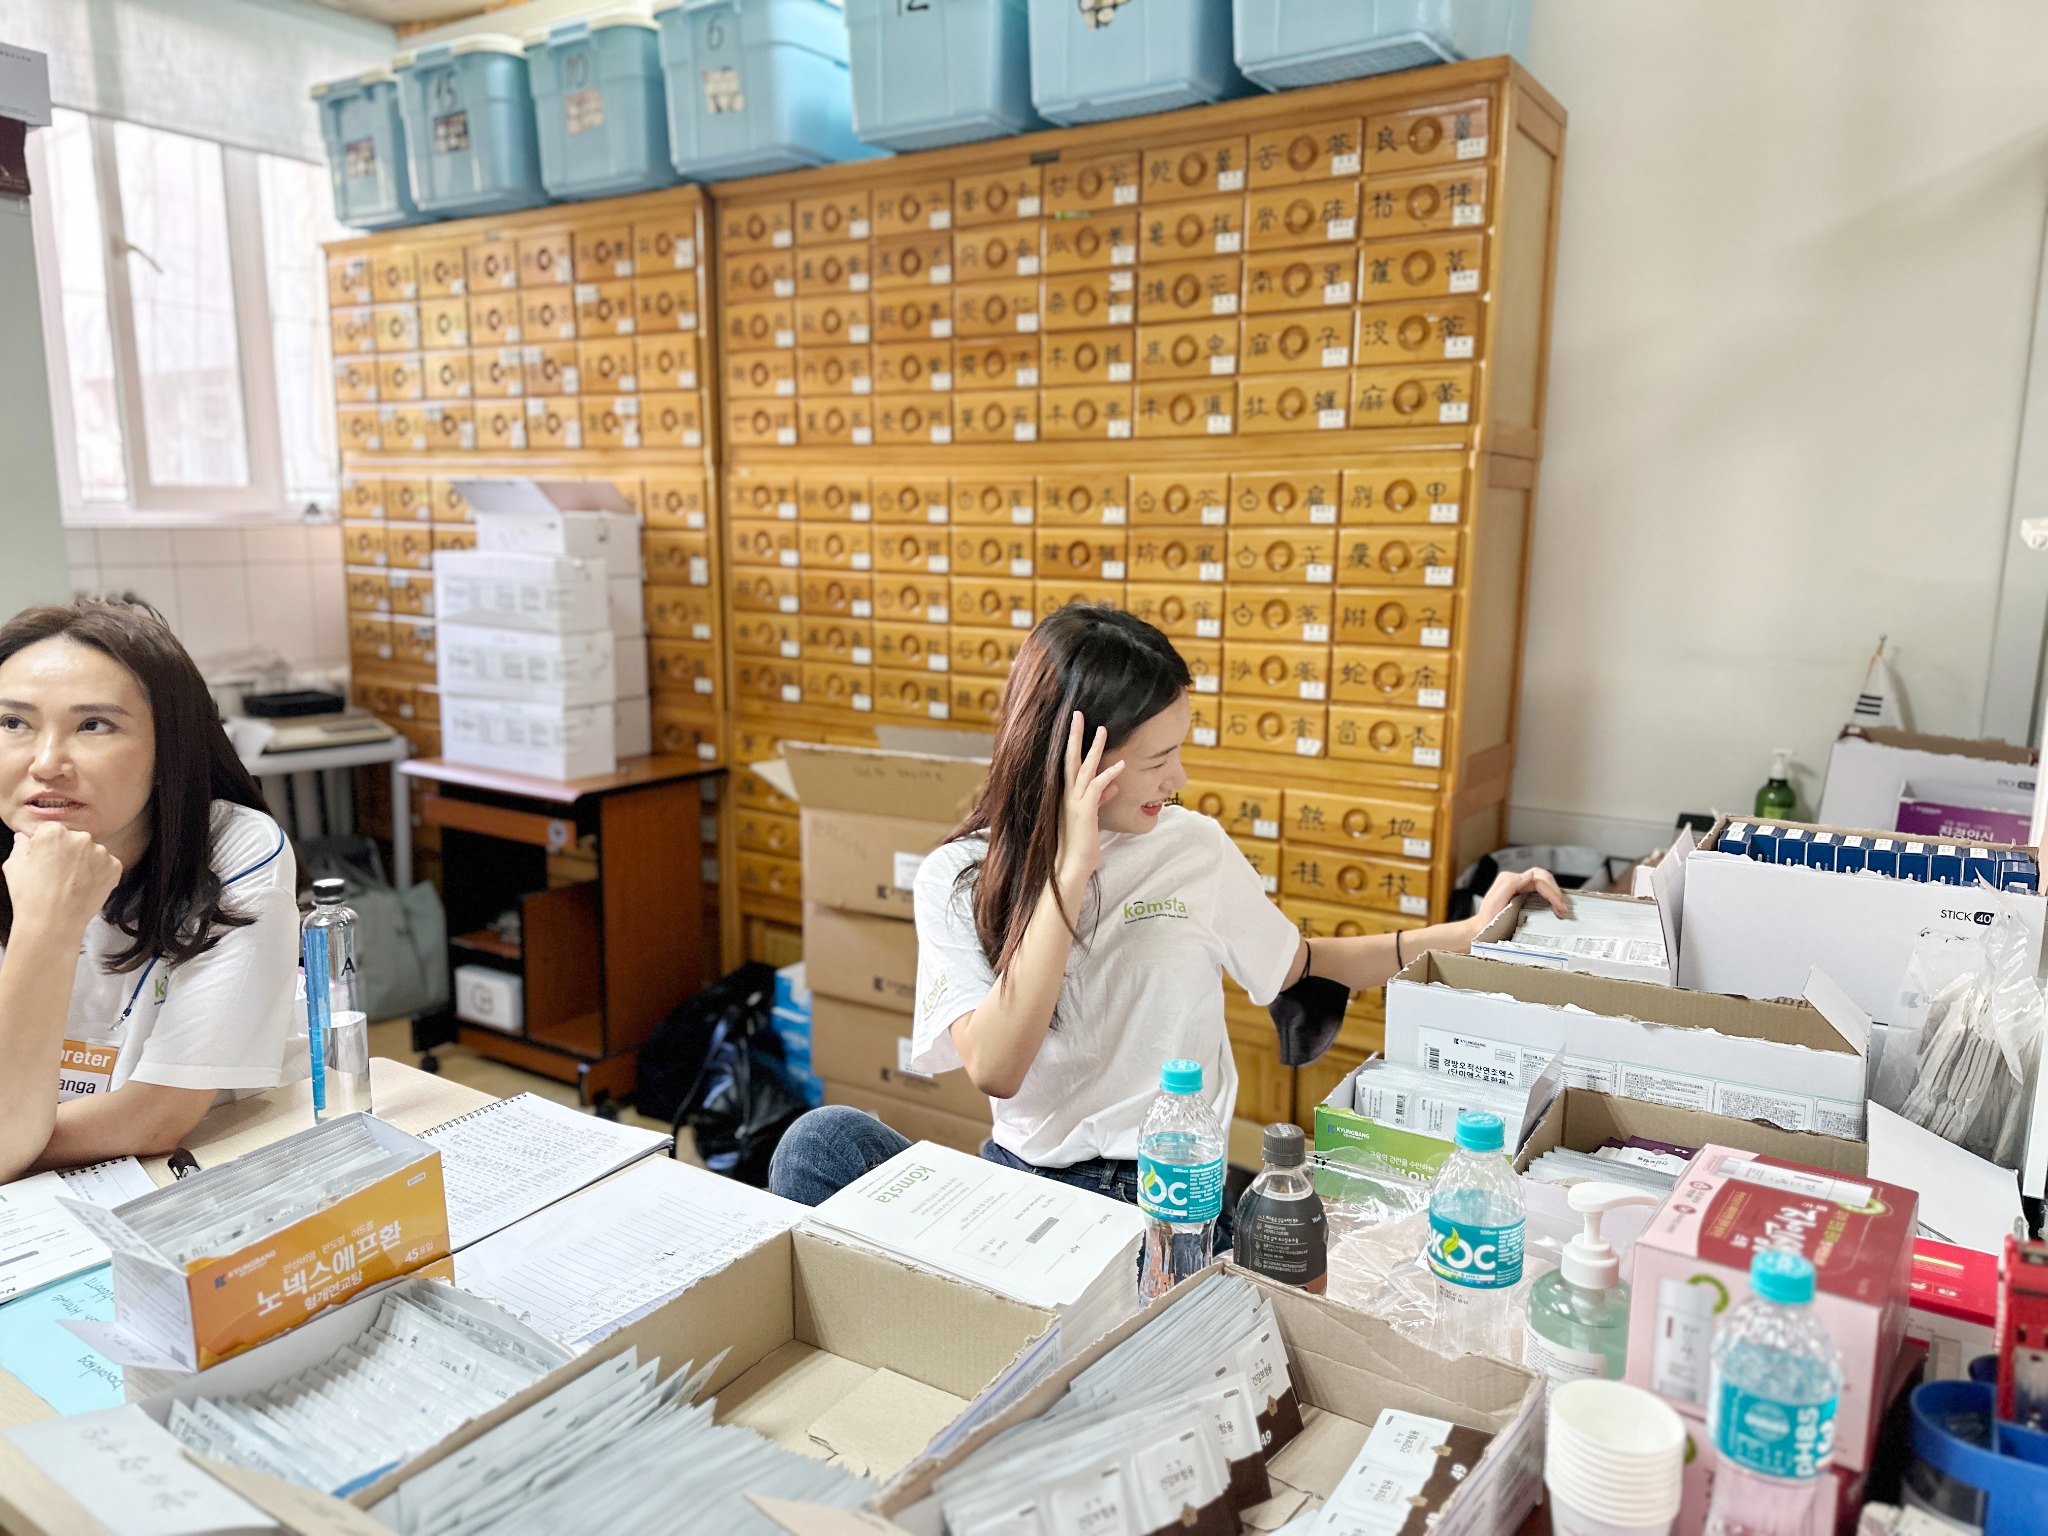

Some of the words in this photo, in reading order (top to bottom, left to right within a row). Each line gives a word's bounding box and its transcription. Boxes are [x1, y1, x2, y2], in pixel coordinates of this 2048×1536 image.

[707, 13, 724, 50] 6
[1381, 817, 1416, 840] 地
[1940, 909, 1972, 922] STICK
[341, 956, 357, 976] A
[227, 1249, 277, 1279] KYUNGBANG
[1450, 1462, 1468, 1482] 49
